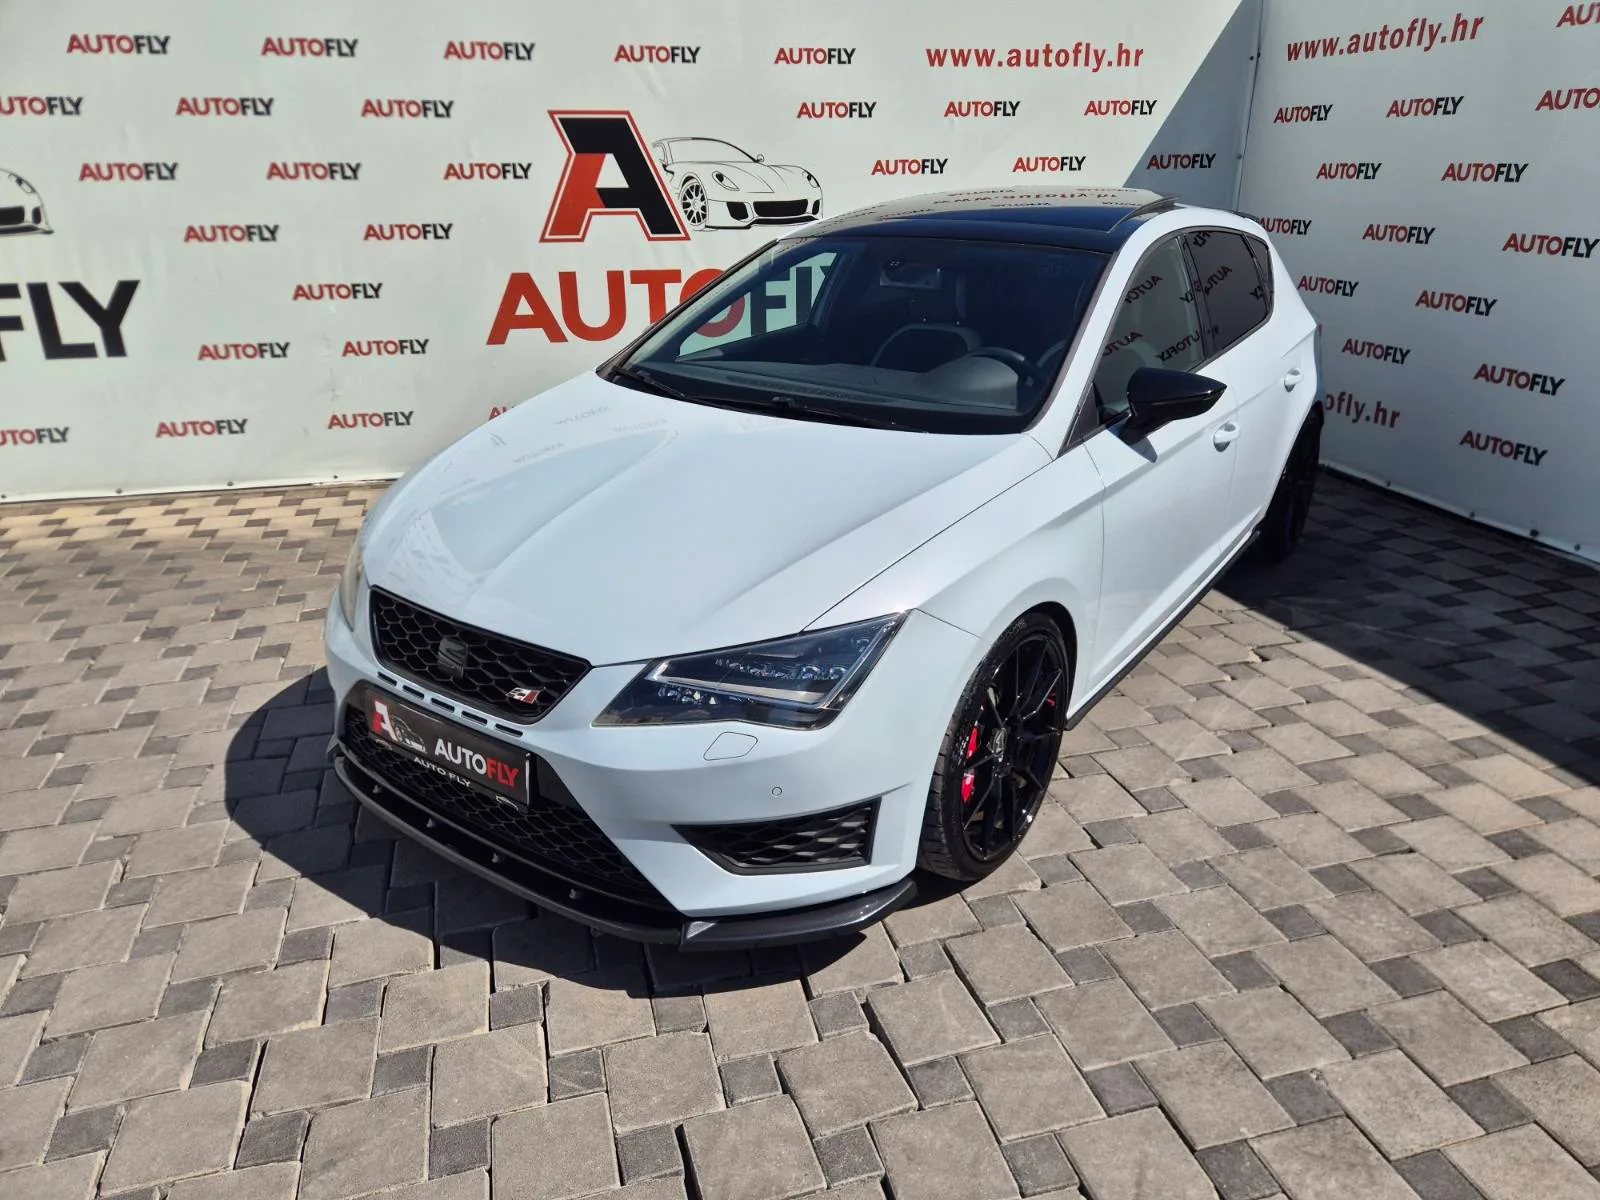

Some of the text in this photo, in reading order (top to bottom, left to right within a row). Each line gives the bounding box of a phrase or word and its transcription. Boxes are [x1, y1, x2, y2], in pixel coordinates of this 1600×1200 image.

[67, 34, 170, 54] AUTOFLY
[1288, 13, 1484, 61] www.autofly.hr
[261, 38, 358, 57] AUTOFLY
[444, 41, 535, 60] AUTOFLY
[615, 45, 700, 63] AUTOFLY
[775, 48, 856, 64] AUTOFLY
[926, 42, 1143, 72] www.autofly.hr
[176, 98, 274, 116] AUTOFLY
[361, 99, 454, 118] AUTOFLY
[797, 102, 876, 118] AUTOFLY
[944, 101, 1020, 117] AUTOFLY
[1084, 100, 1157, 115] AUTOFLY
[1274, 104, 1333, 123] AUTOFLY
[1386, 96, 1464, 117] AUTOFLY
[872, 159, 948, 175] AUTOFLY
[1013, 156, 1086, 172] AUTOFLY
[1147, 153, 1216, 169] AUTOFLY
[79, 163, 178, 181] AUTOFLY
[267, 162, 361, 180] AUTOFLY
[444, 163, 532, 180] AUTOFLY
[1316, 163, 1382, 179] AUTOFLY
[1441, 163, 1528, 182] AUTOFLY
[184, 225, 279, 242] AUTOFLY
[364, 223, 453, 240] AUTOFLY
[1362, 224, 1435, 244] AUTOFLY
[1502, 233, 1600, 258] AUTOFLY
[293, 283, 382, 300] AUTOFLY
[1297, 276, 1359, 297] AUTOFLY
[1415, 291, 1498, 316] AUTOFLY
[198, 342, 290, 360] AUTOFLY
[342, 339, 429, 357] AUTOFLY
[1342, 339, 1411, 365] AUTOFLY
[1473, 364, 1565, 396] AUTOFLY
[156, 419, 248, 438] AUTOFLY
[328, 411, 414, 429] AUTOFLY
[1459, 430, 1548, 466] AUTOFLY
[414, 756, 471, 787] AUTO FLY
[434, 738, 519, 788] AUTOFLY
